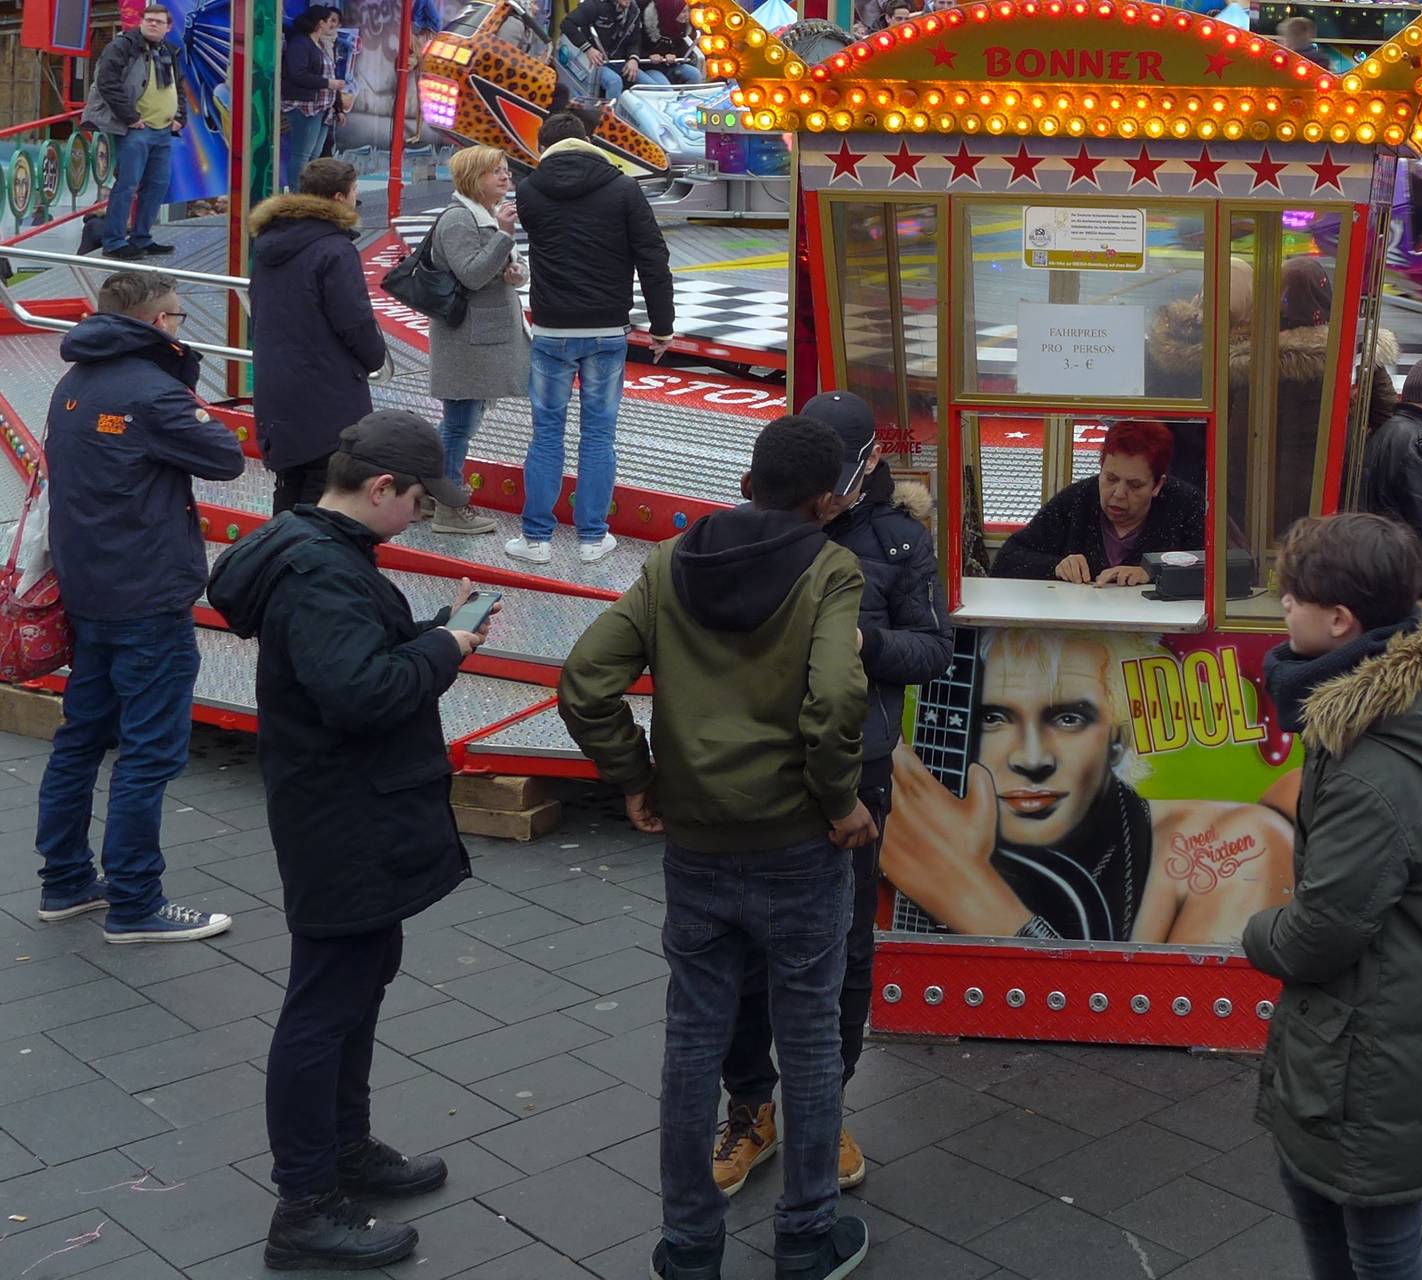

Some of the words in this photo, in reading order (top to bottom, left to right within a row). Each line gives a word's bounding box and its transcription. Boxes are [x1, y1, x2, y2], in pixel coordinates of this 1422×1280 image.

[984, 46, 1165, 82] BONNER
[1049, 327, 1108, 338] FAHRPREIS
[1041, 343, 1063, 353] PRO
[1073, 344, 1116, 354] PERSON
[1085, 358, 1095, 370] €
[1121, 645, 1268, 756] IDOL
[1132, 699, 1224, 721] BILLY
[1165, 824, 1216, 880] Sweet
[1187, 834, 1255, 896] Sixteen
